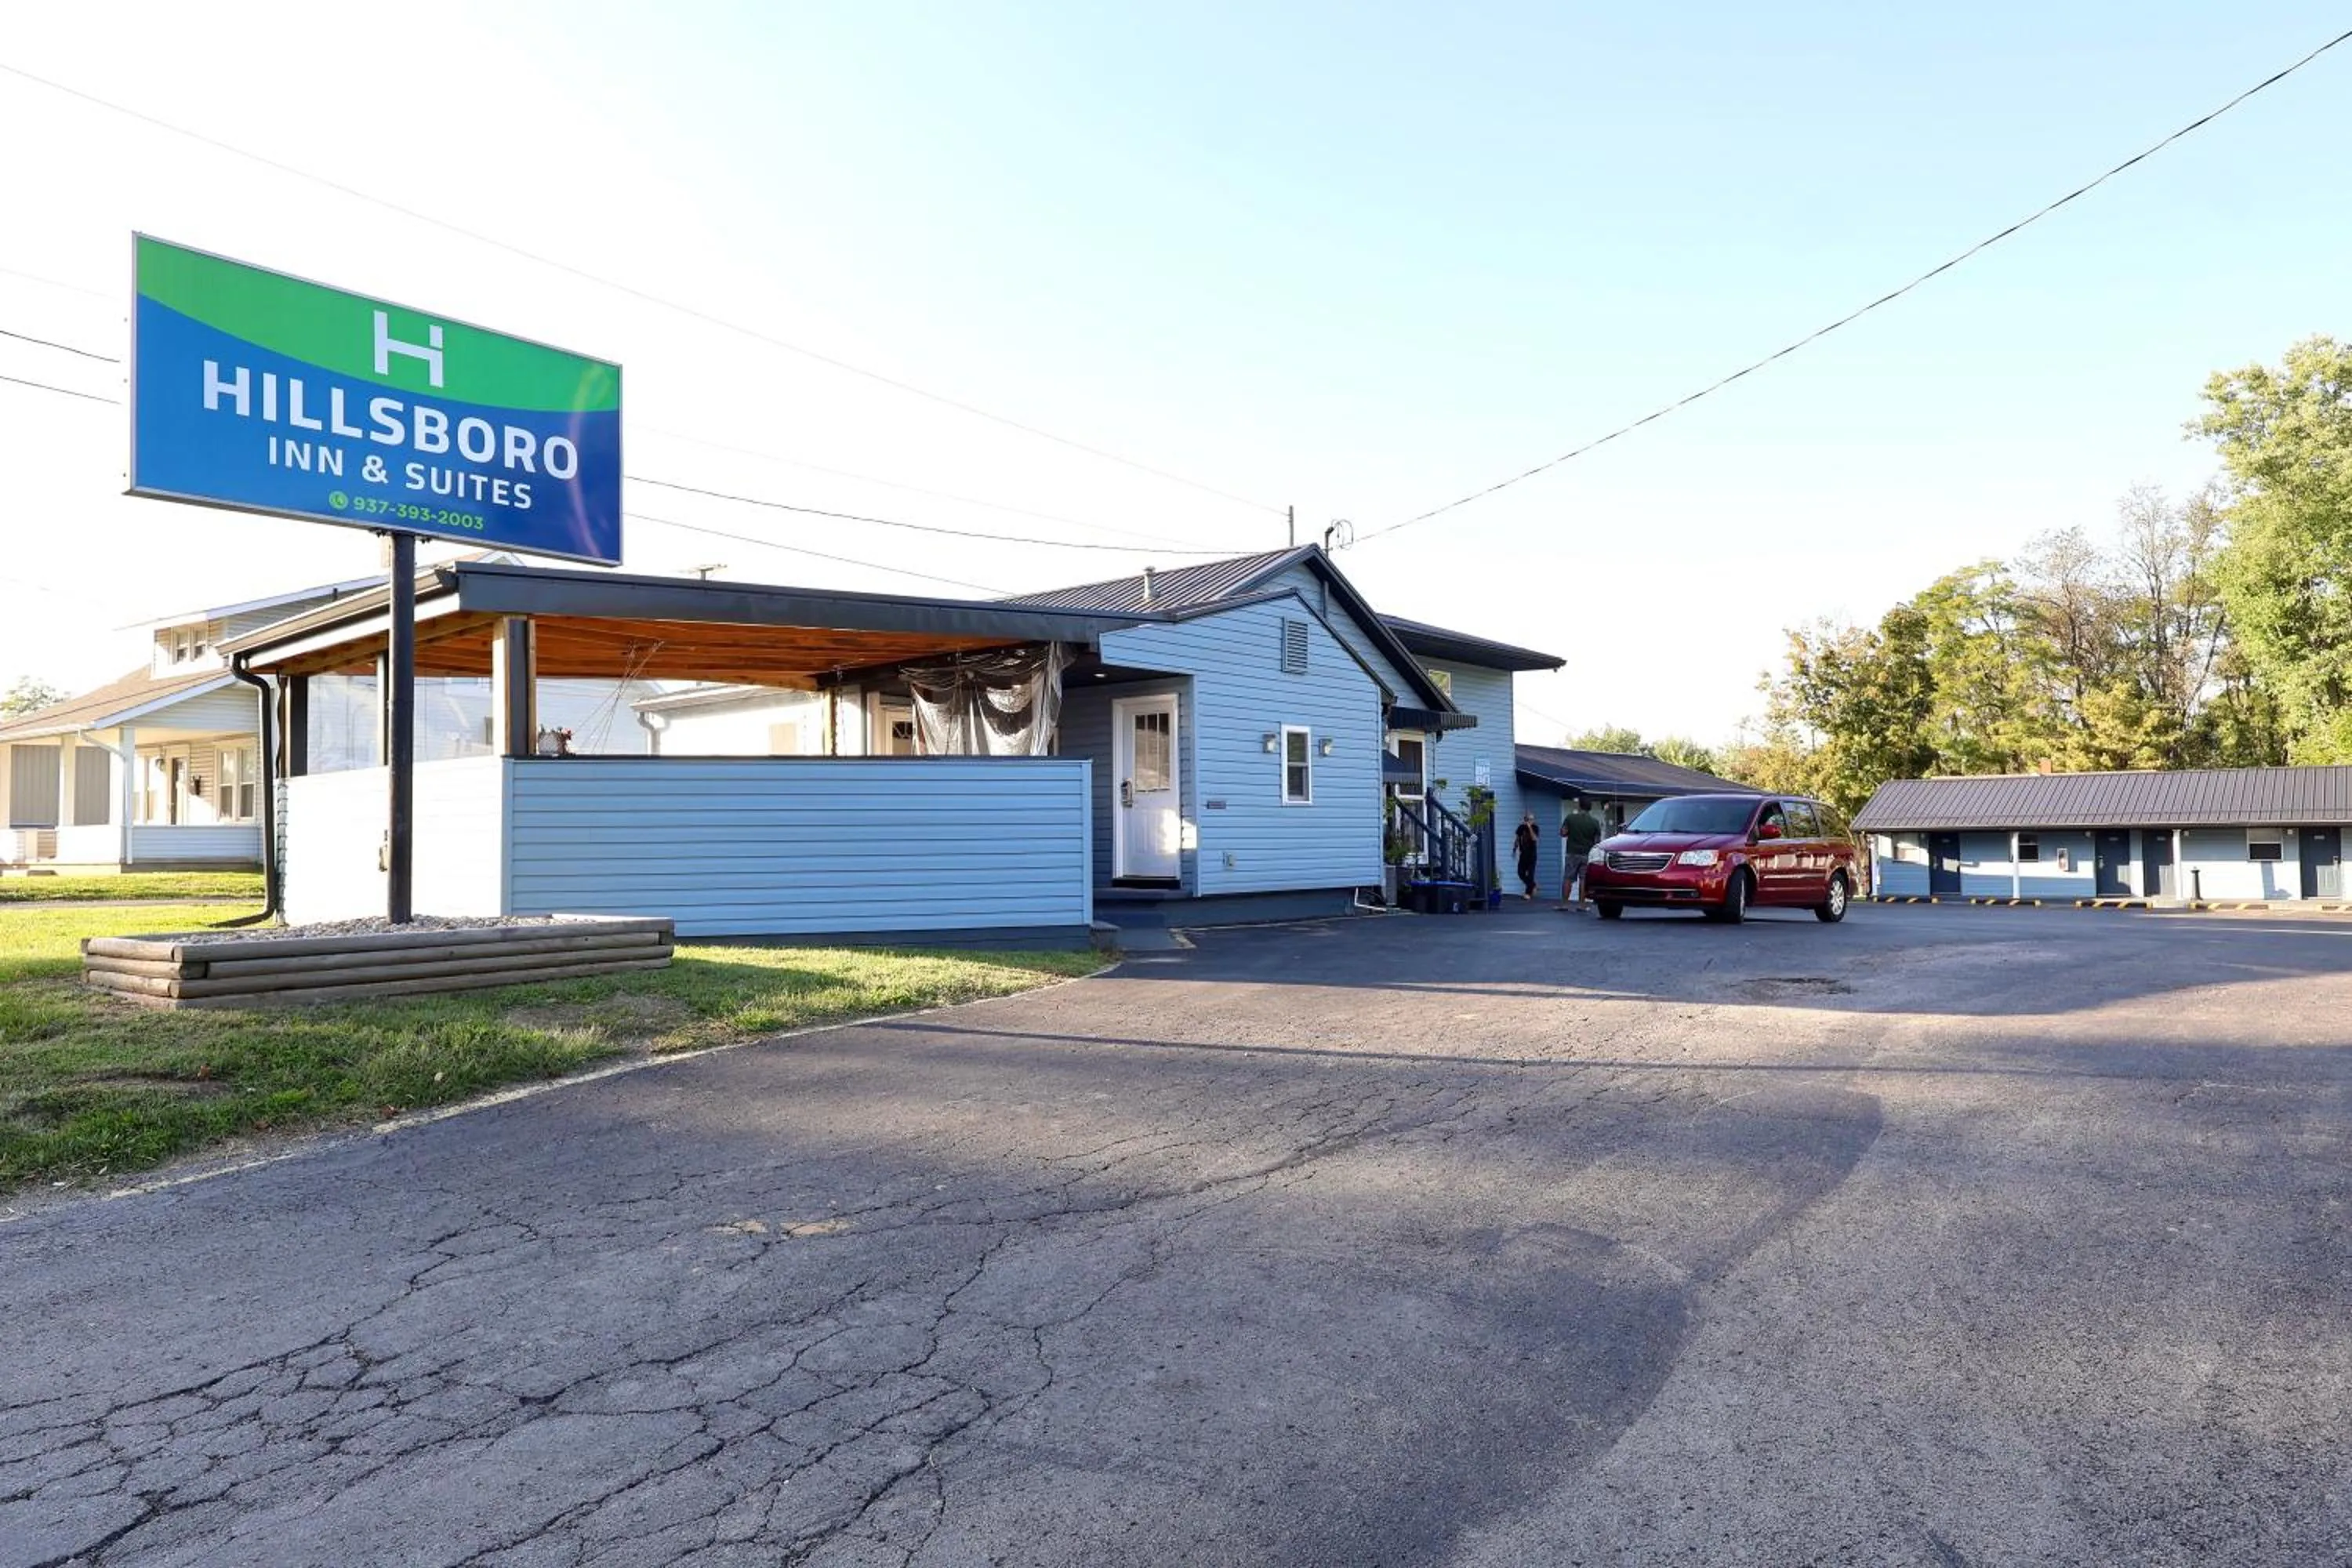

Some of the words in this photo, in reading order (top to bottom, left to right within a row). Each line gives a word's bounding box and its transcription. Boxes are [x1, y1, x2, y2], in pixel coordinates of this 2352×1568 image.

[373, 310, 443, 387] H
[203, 360, 579, 479] HILLSBORO
[269, 436, 343, 476] INN
[361, 455, 389, 485] &
[405, 463, 532, 510] SUITES
[353, 497, 484, 530] 937-393-2003
